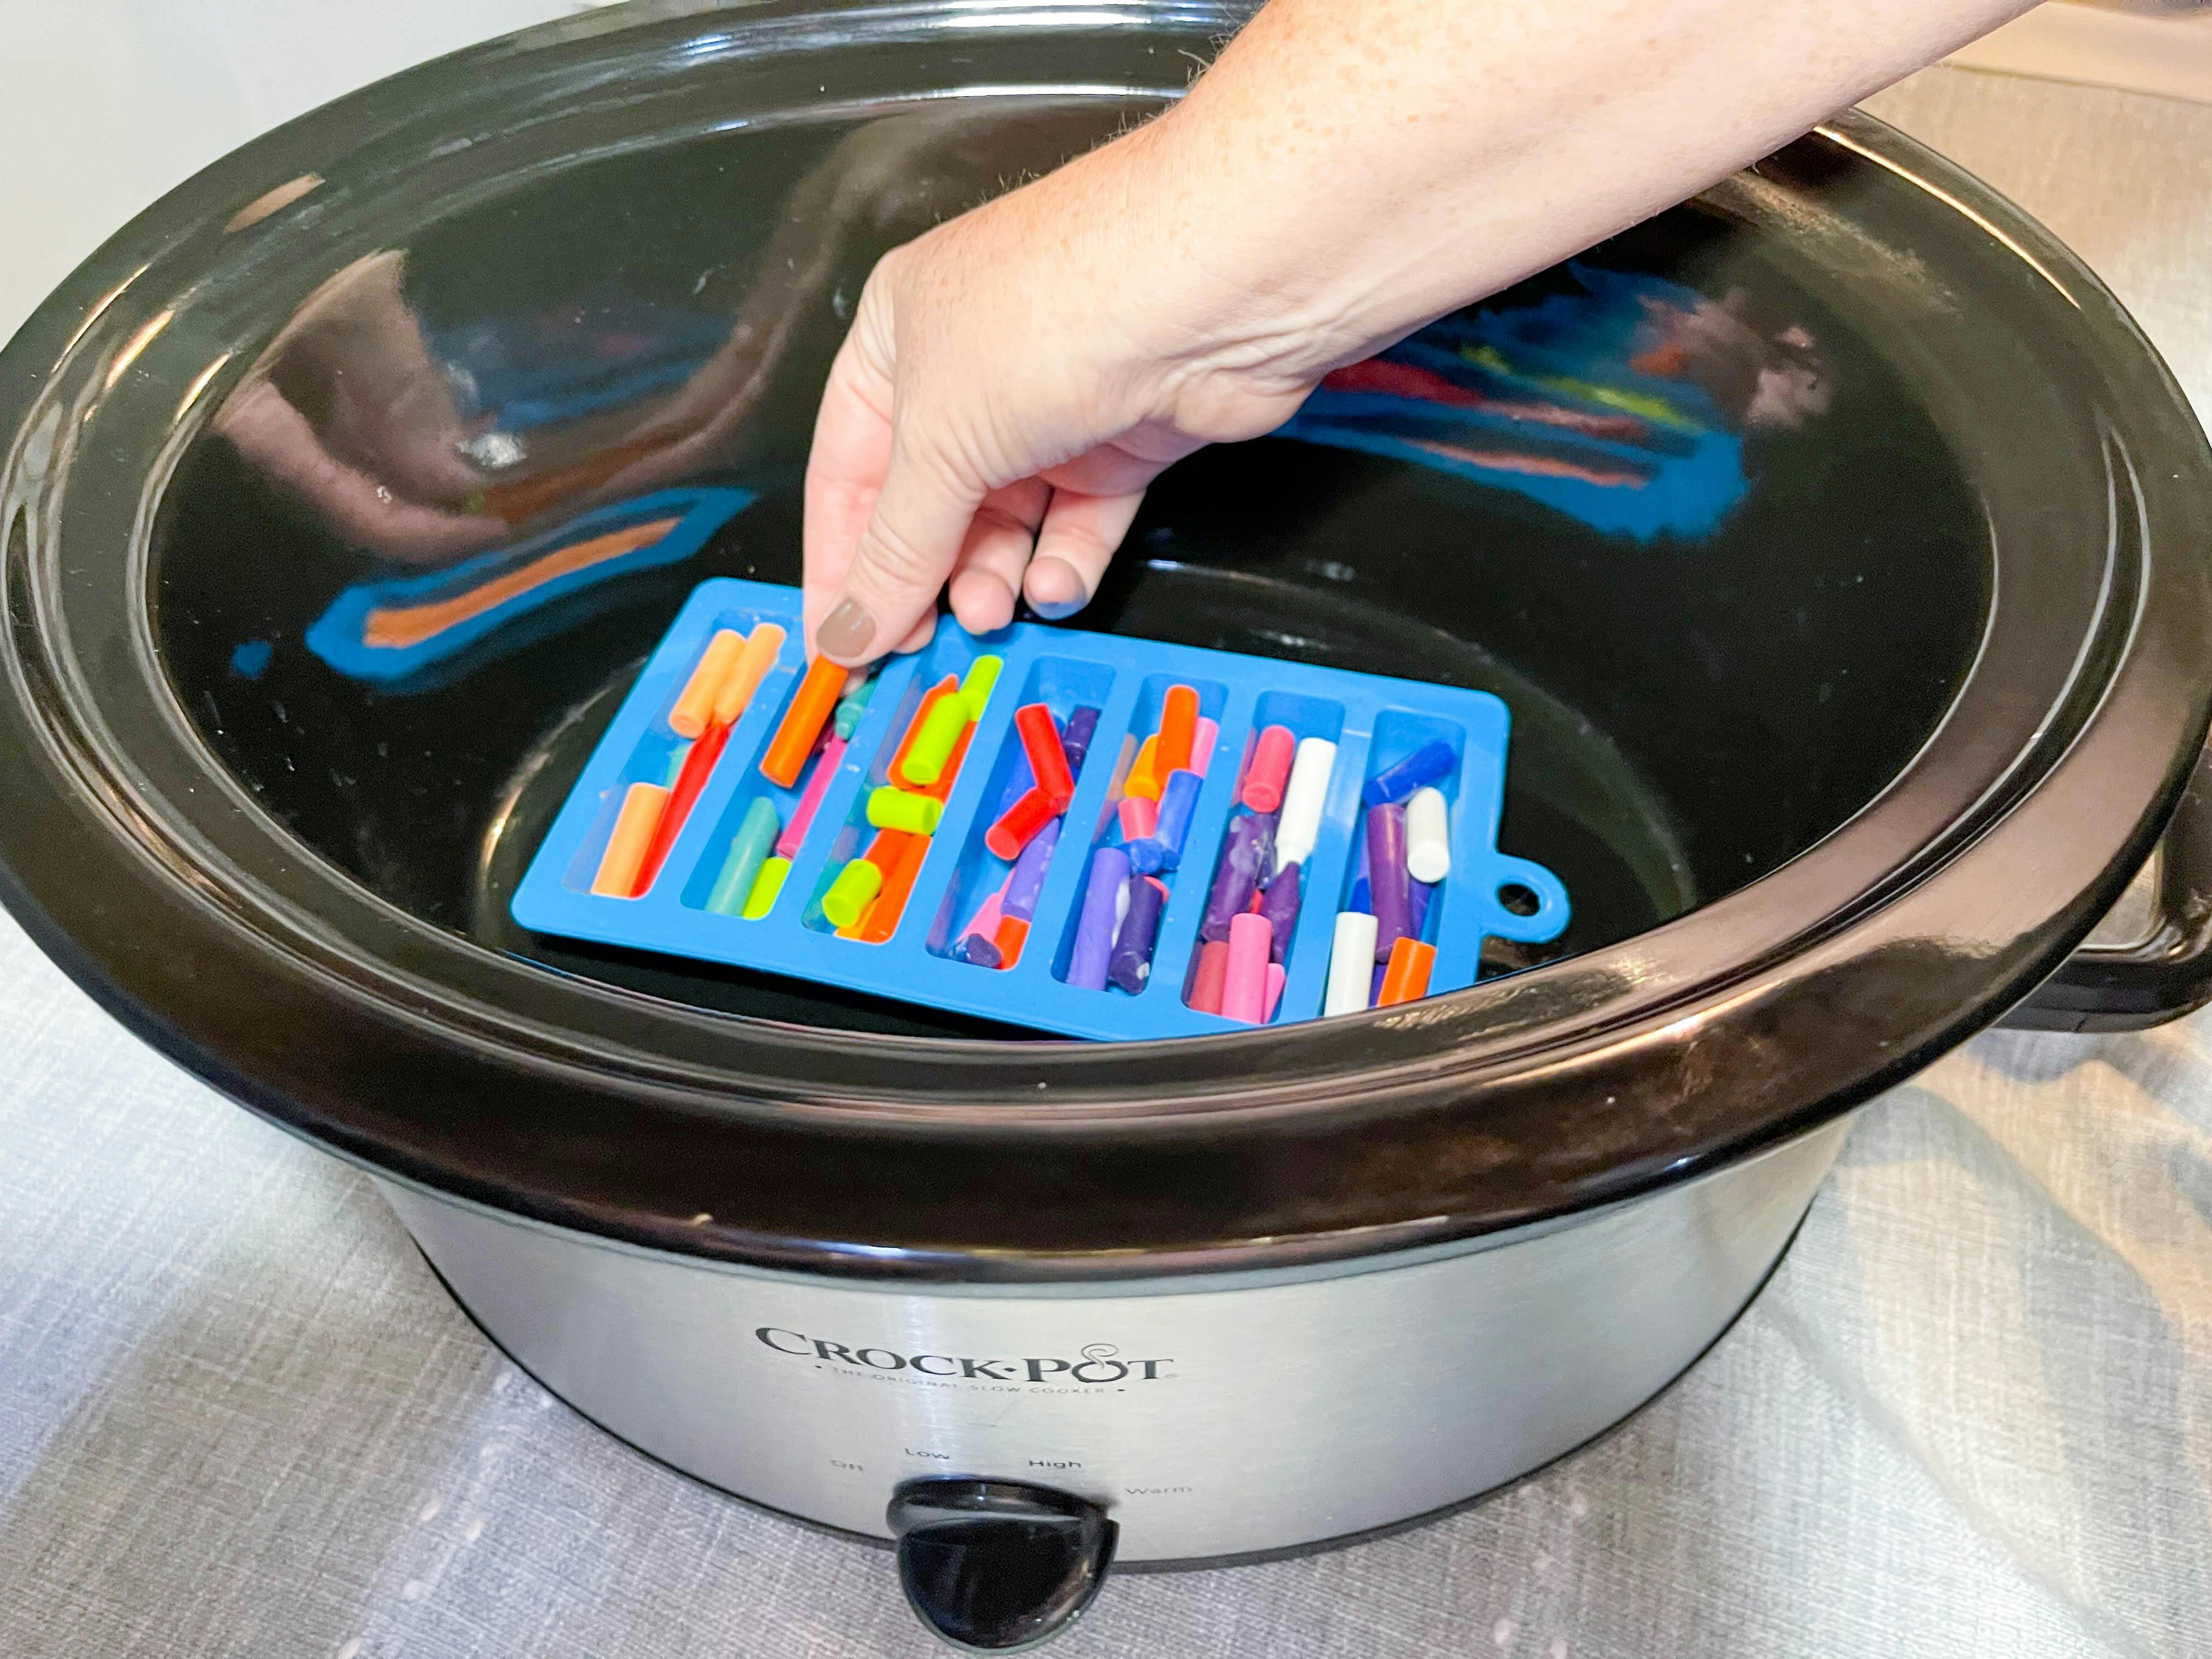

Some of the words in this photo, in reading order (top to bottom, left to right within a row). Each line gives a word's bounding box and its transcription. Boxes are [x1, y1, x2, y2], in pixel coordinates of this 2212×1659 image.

[970, 1385, 1020, 1393] SLOW
[905, 1448, 950, 1459] Low
[1029, 1460, 1081, 1469] High
